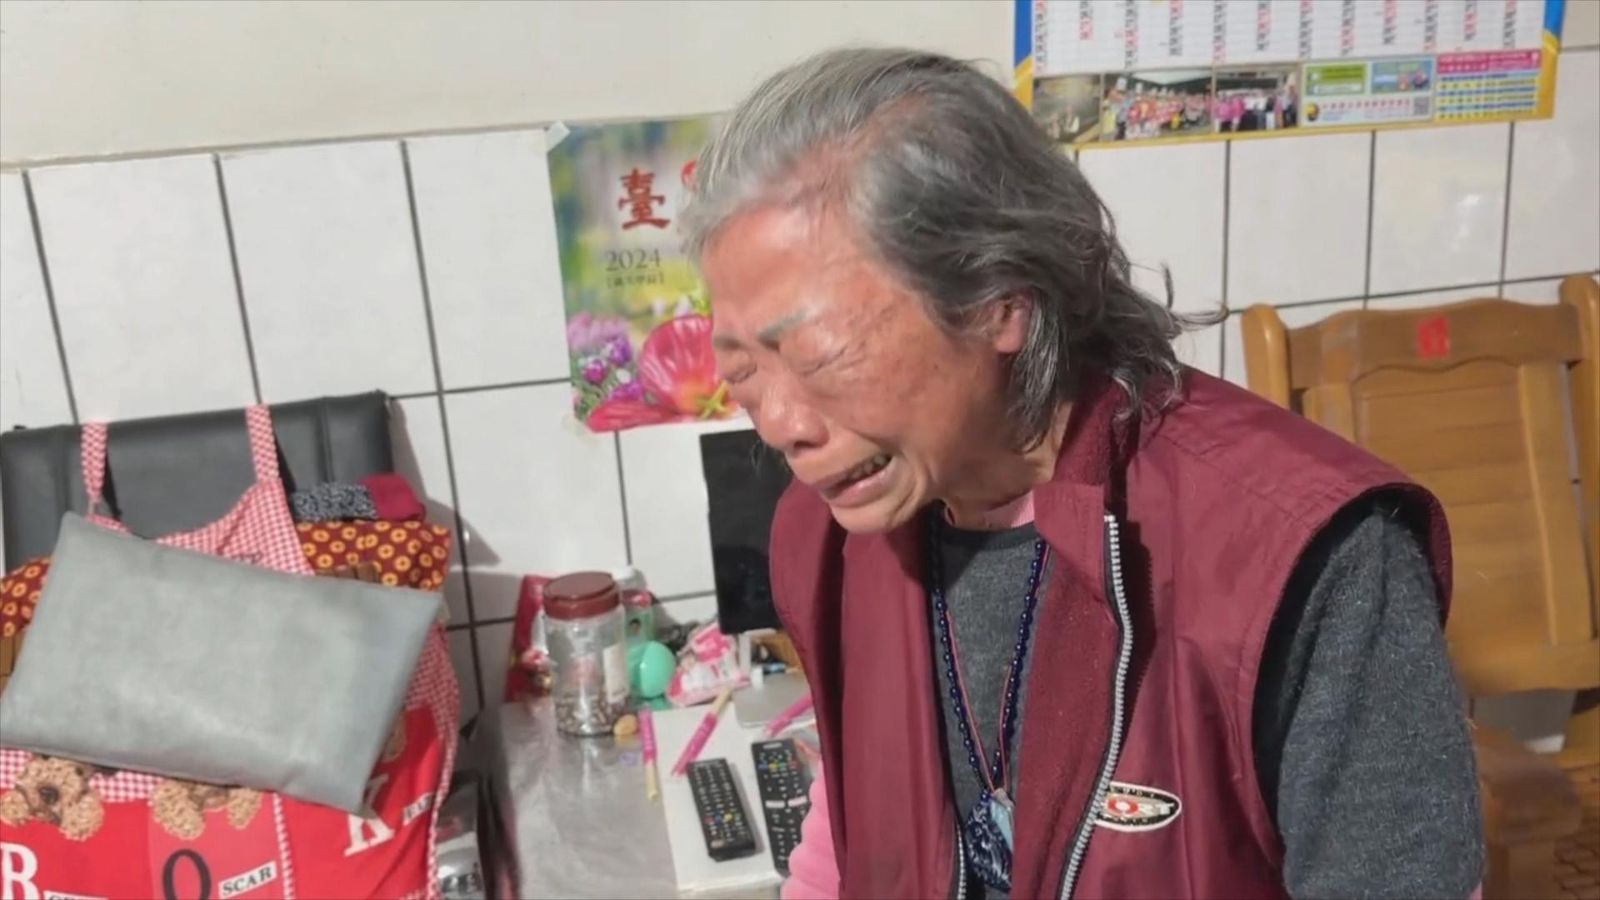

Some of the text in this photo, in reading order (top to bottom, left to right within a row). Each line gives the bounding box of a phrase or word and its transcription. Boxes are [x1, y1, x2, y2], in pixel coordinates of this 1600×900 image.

[618, 168, 671, 230] 臺
[605, 248, 661, 272] 2024
[222, 866, 272, 897] SCAR
